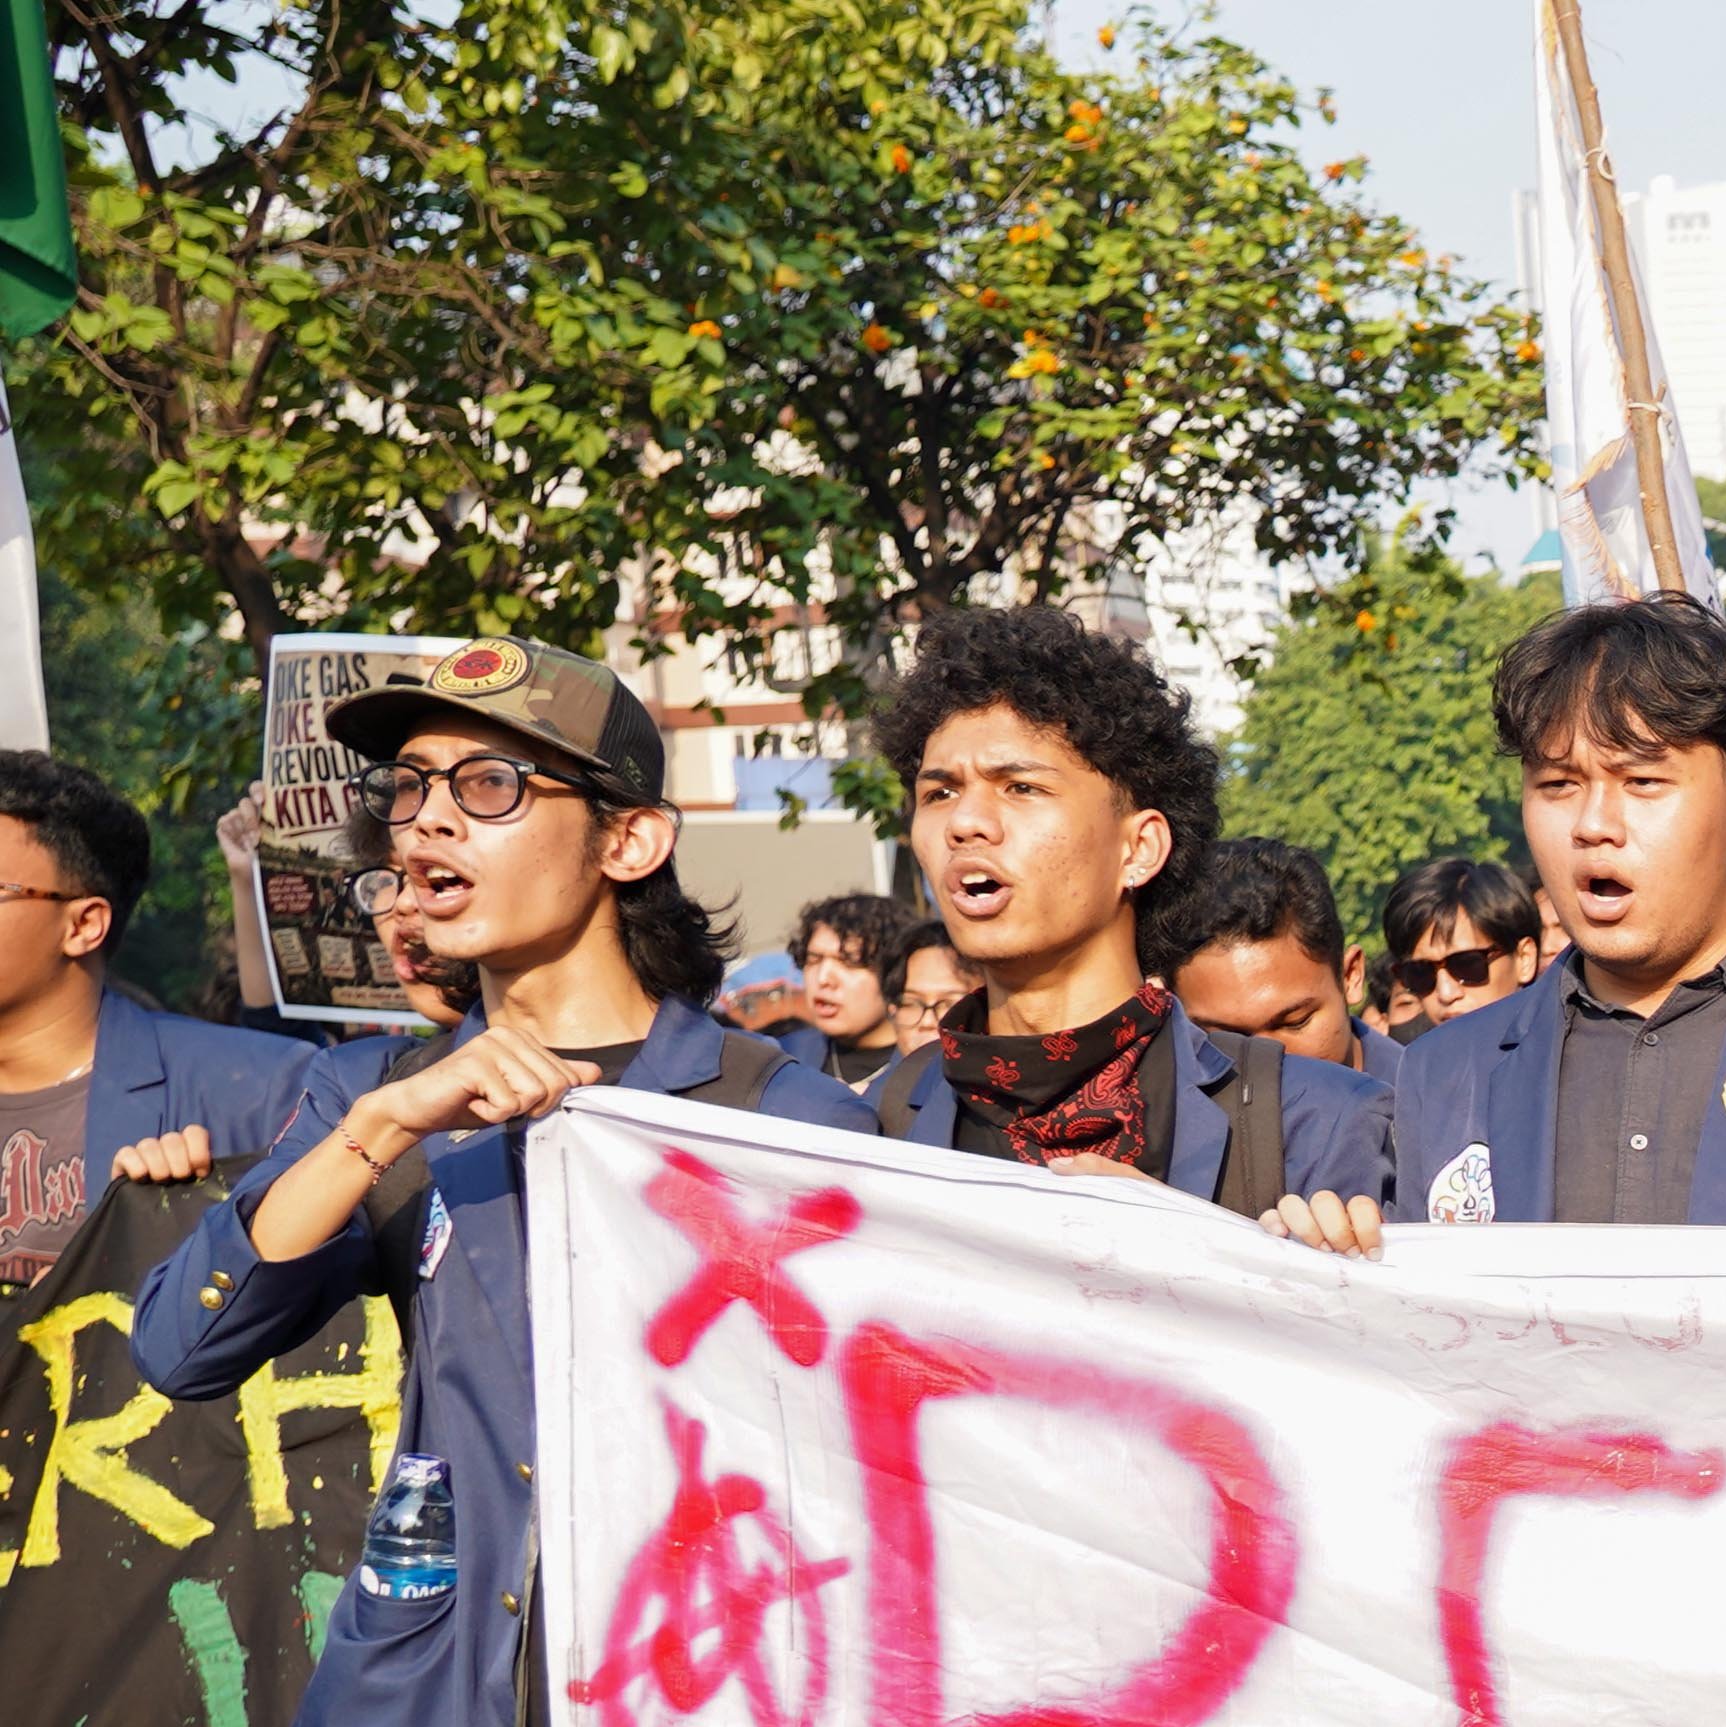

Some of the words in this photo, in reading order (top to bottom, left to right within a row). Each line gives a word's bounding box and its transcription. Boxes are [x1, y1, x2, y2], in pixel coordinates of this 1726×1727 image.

[273, 658, 312, 703] OKE
[319, 653, 370, 696] GAS
[272, 702, 317, 746] OKE
[274, 786, 338, 829] KITA
